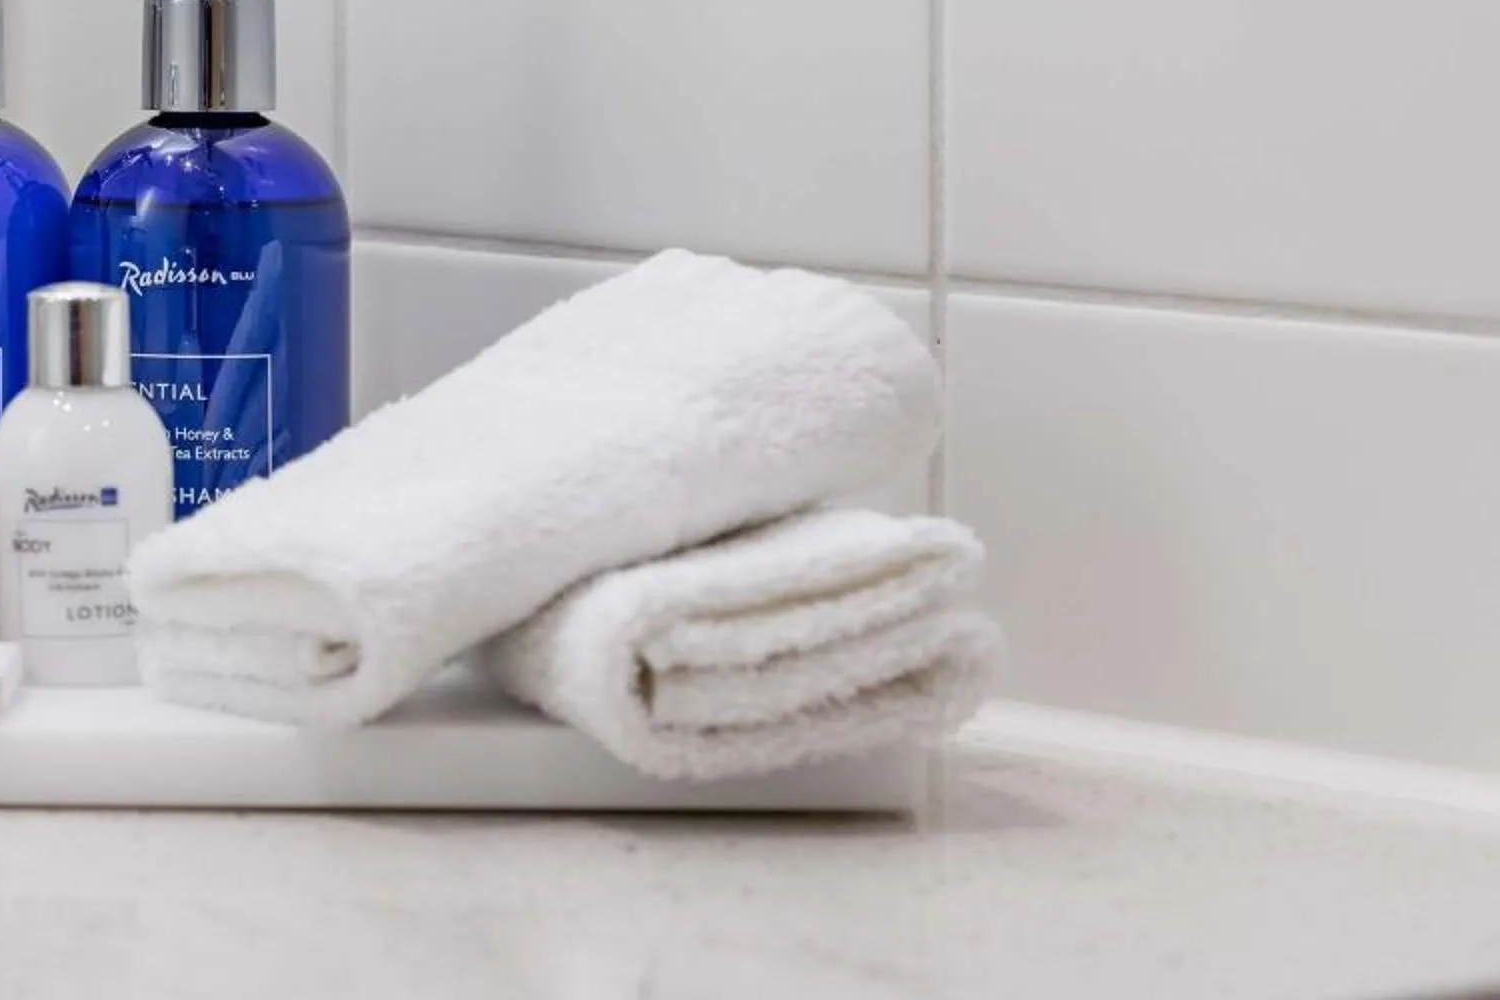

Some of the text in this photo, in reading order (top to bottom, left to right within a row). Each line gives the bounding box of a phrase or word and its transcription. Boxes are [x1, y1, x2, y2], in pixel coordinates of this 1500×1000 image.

[120, 257, 227, 296] Radisson
[132, 382, 209, 401] NTIAL
[175, 427, 219, 443] Honey
[223, 427, 235, 441] &
[195, 446, 251, 461] Extracts
